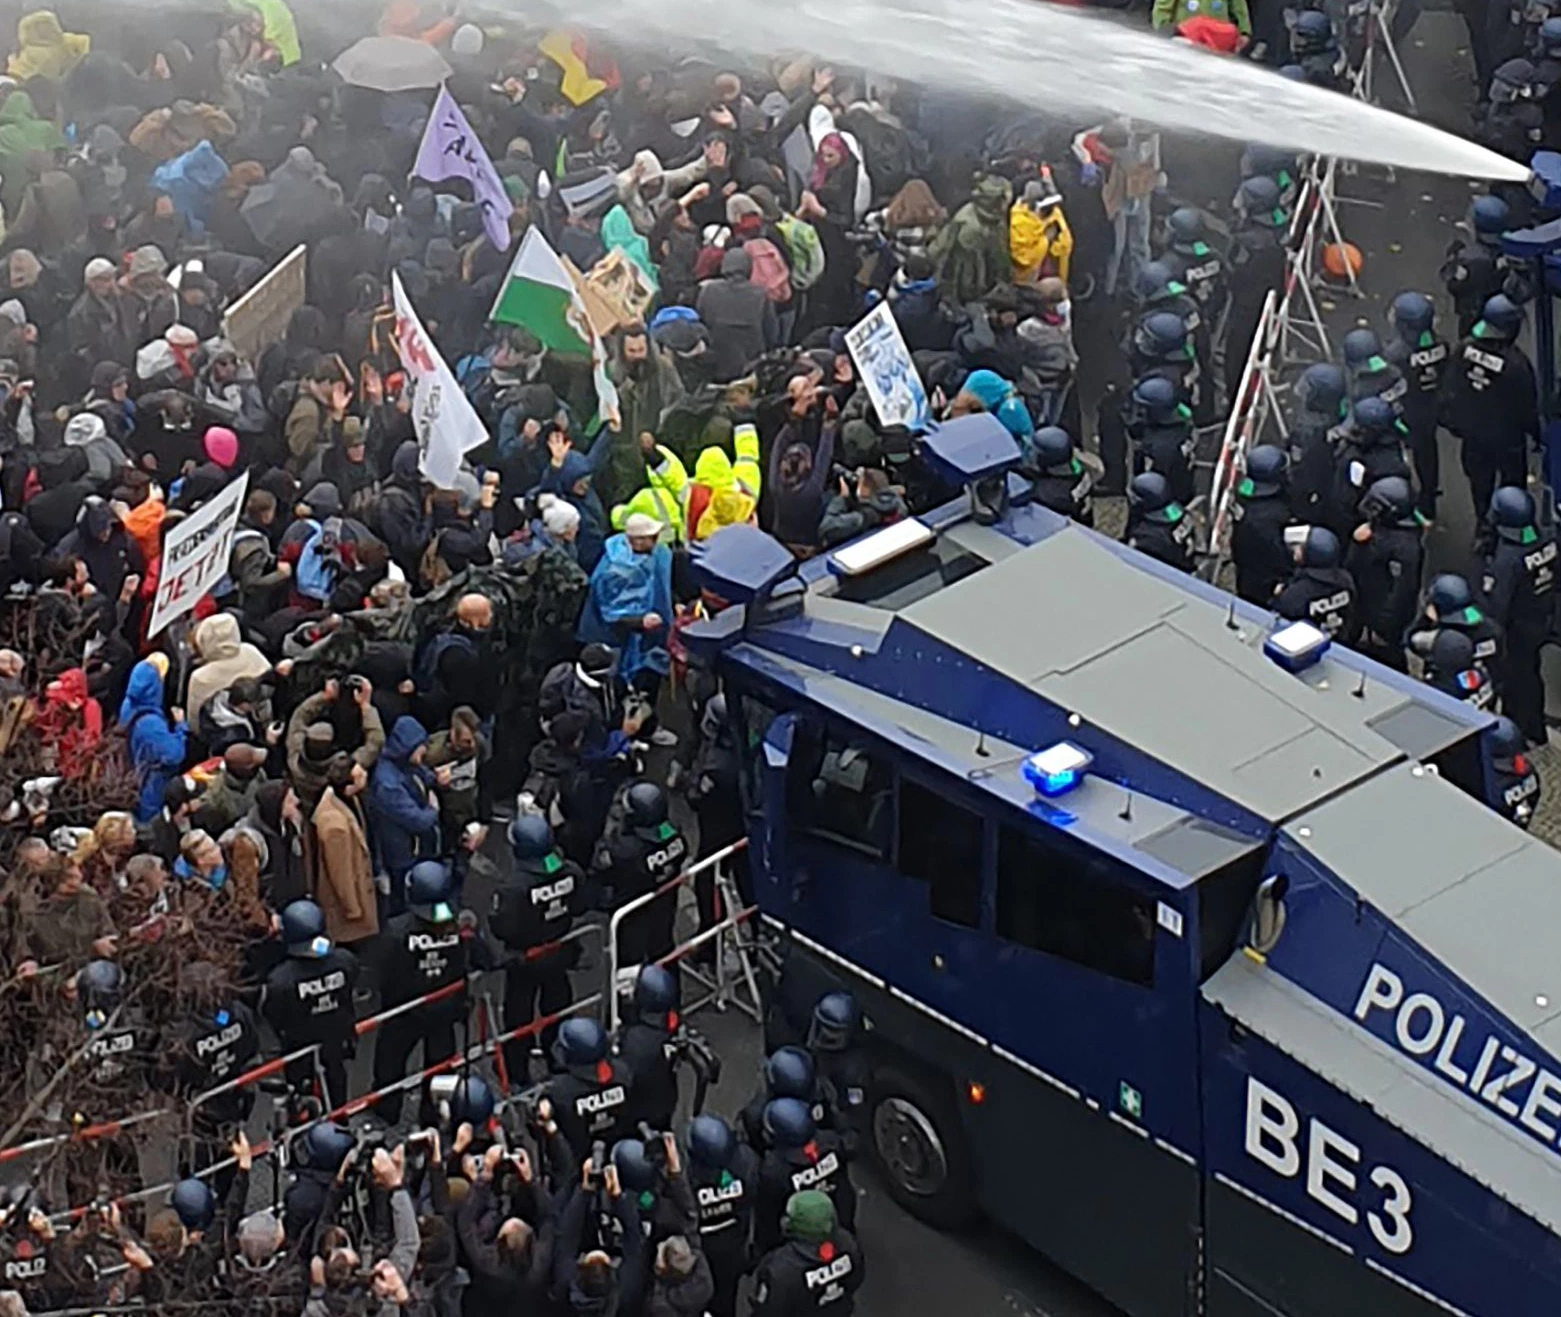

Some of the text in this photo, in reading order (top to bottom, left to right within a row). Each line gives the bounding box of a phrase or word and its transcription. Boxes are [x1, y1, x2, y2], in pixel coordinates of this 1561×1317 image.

[298, 971, 346, 1000] POLIZEI
[196, 1022, 243, 1057] POLIZEI
[576, 1086, 625, 1116] POLIZEI
[792, 1152, 839, 1190] POLIZEI
[1246, 1075, 1413, 1254] BE3
[805, 1254, 852, 1288] POLIZEI
